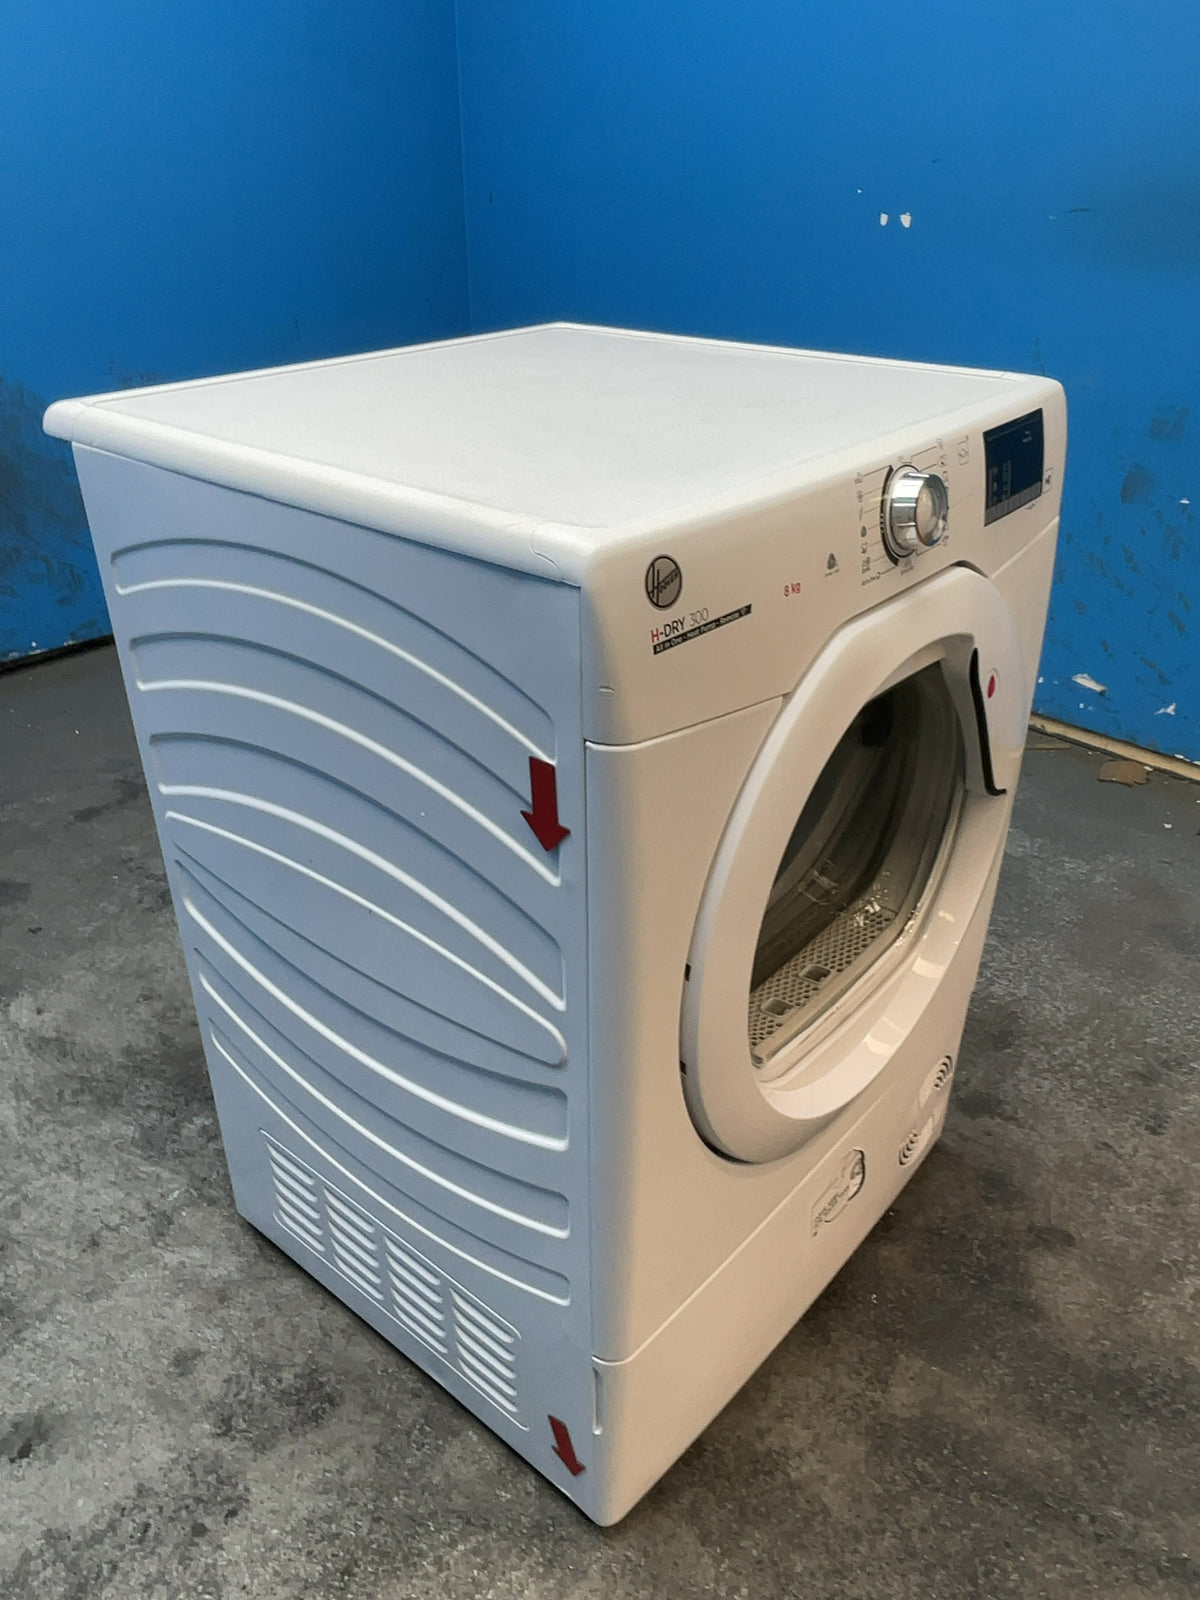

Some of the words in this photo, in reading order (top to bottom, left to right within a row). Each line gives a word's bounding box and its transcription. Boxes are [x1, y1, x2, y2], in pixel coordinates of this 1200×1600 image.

[784, 584, 790, 597] 8
[791, 582, 801, 594] kg
[650, 616, 686, 644] H-DRY
[688, 607, 709, 627] 300
